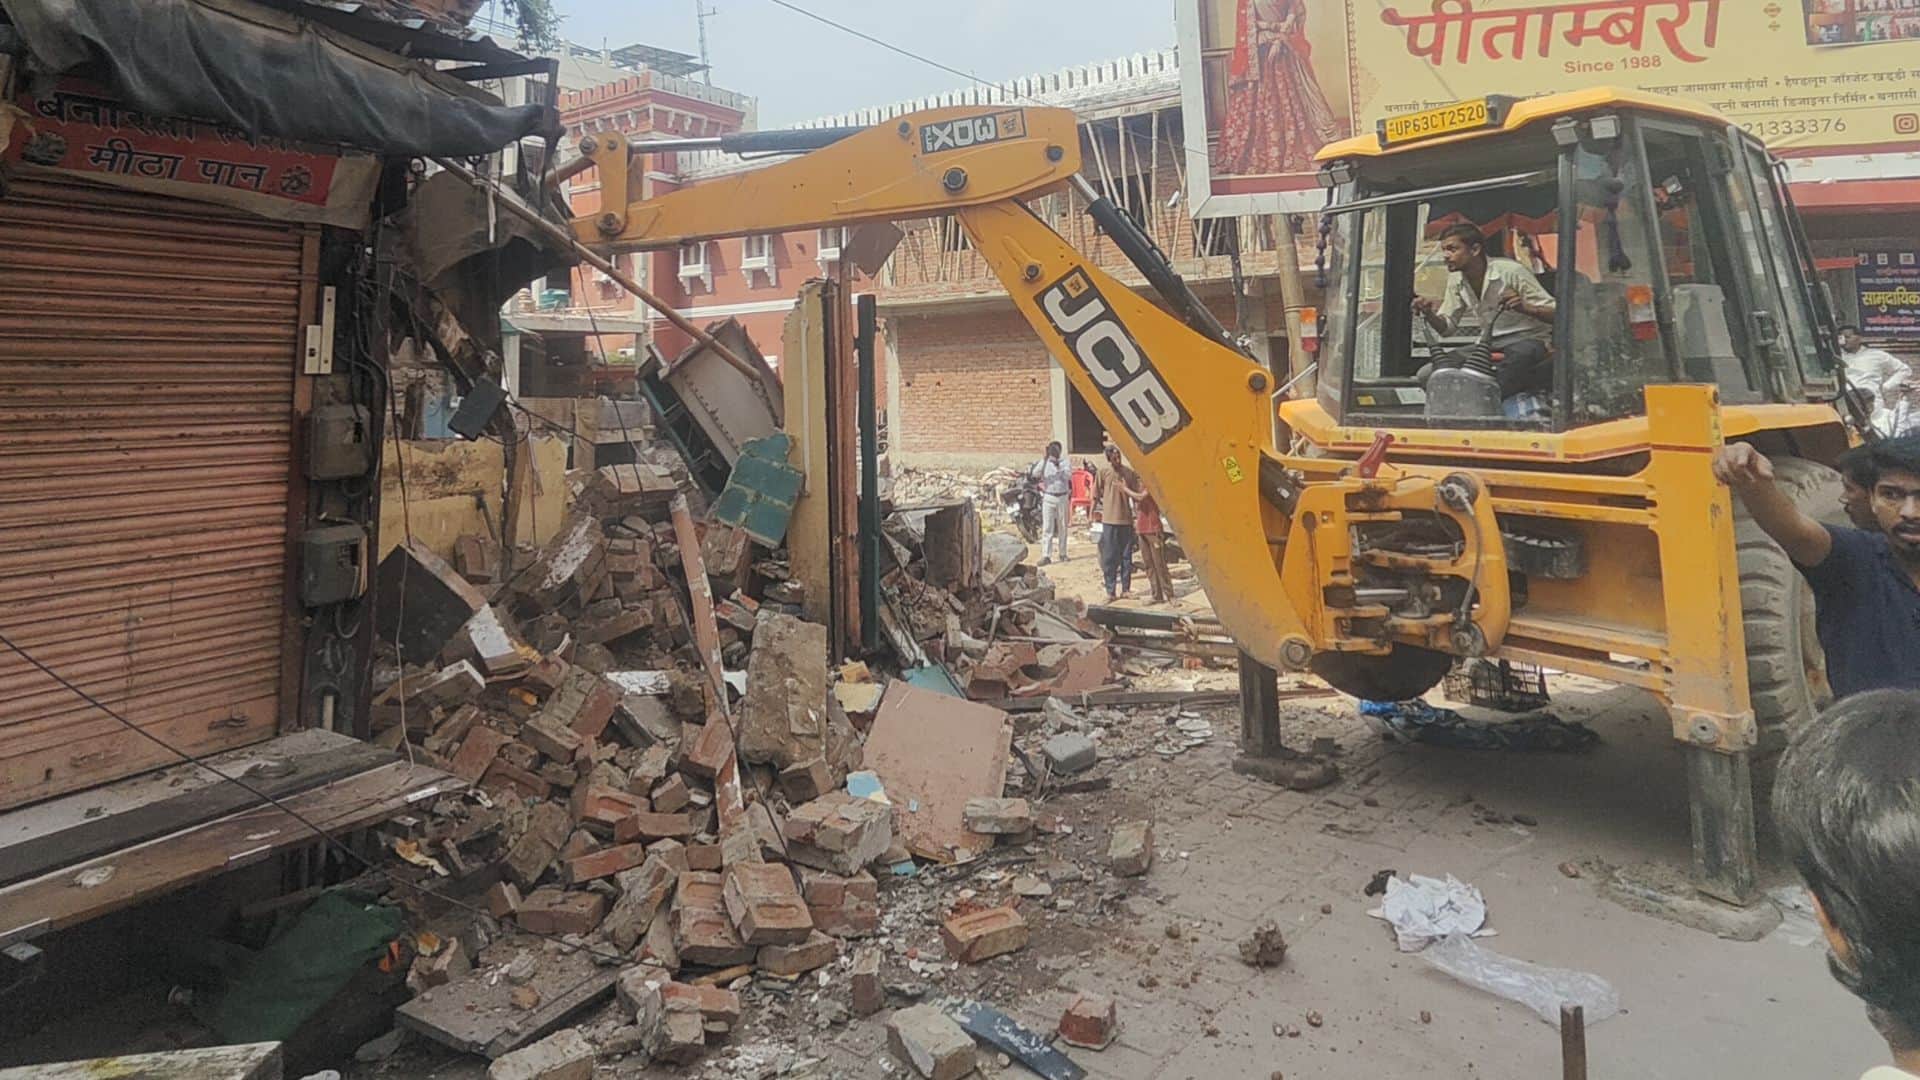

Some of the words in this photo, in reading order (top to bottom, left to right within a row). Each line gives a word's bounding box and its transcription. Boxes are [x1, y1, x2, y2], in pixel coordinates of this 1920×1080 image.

[1564, 59, 1615, 74] Since
[1621, 54, 1662, 70] 1988
[1395, 105, 1486, 137] UP63CT2520
[84, 138, 184, 182] मीठा
[198, 157, 269, 192] पान
[1042, 285, 1182, 444] JCB
